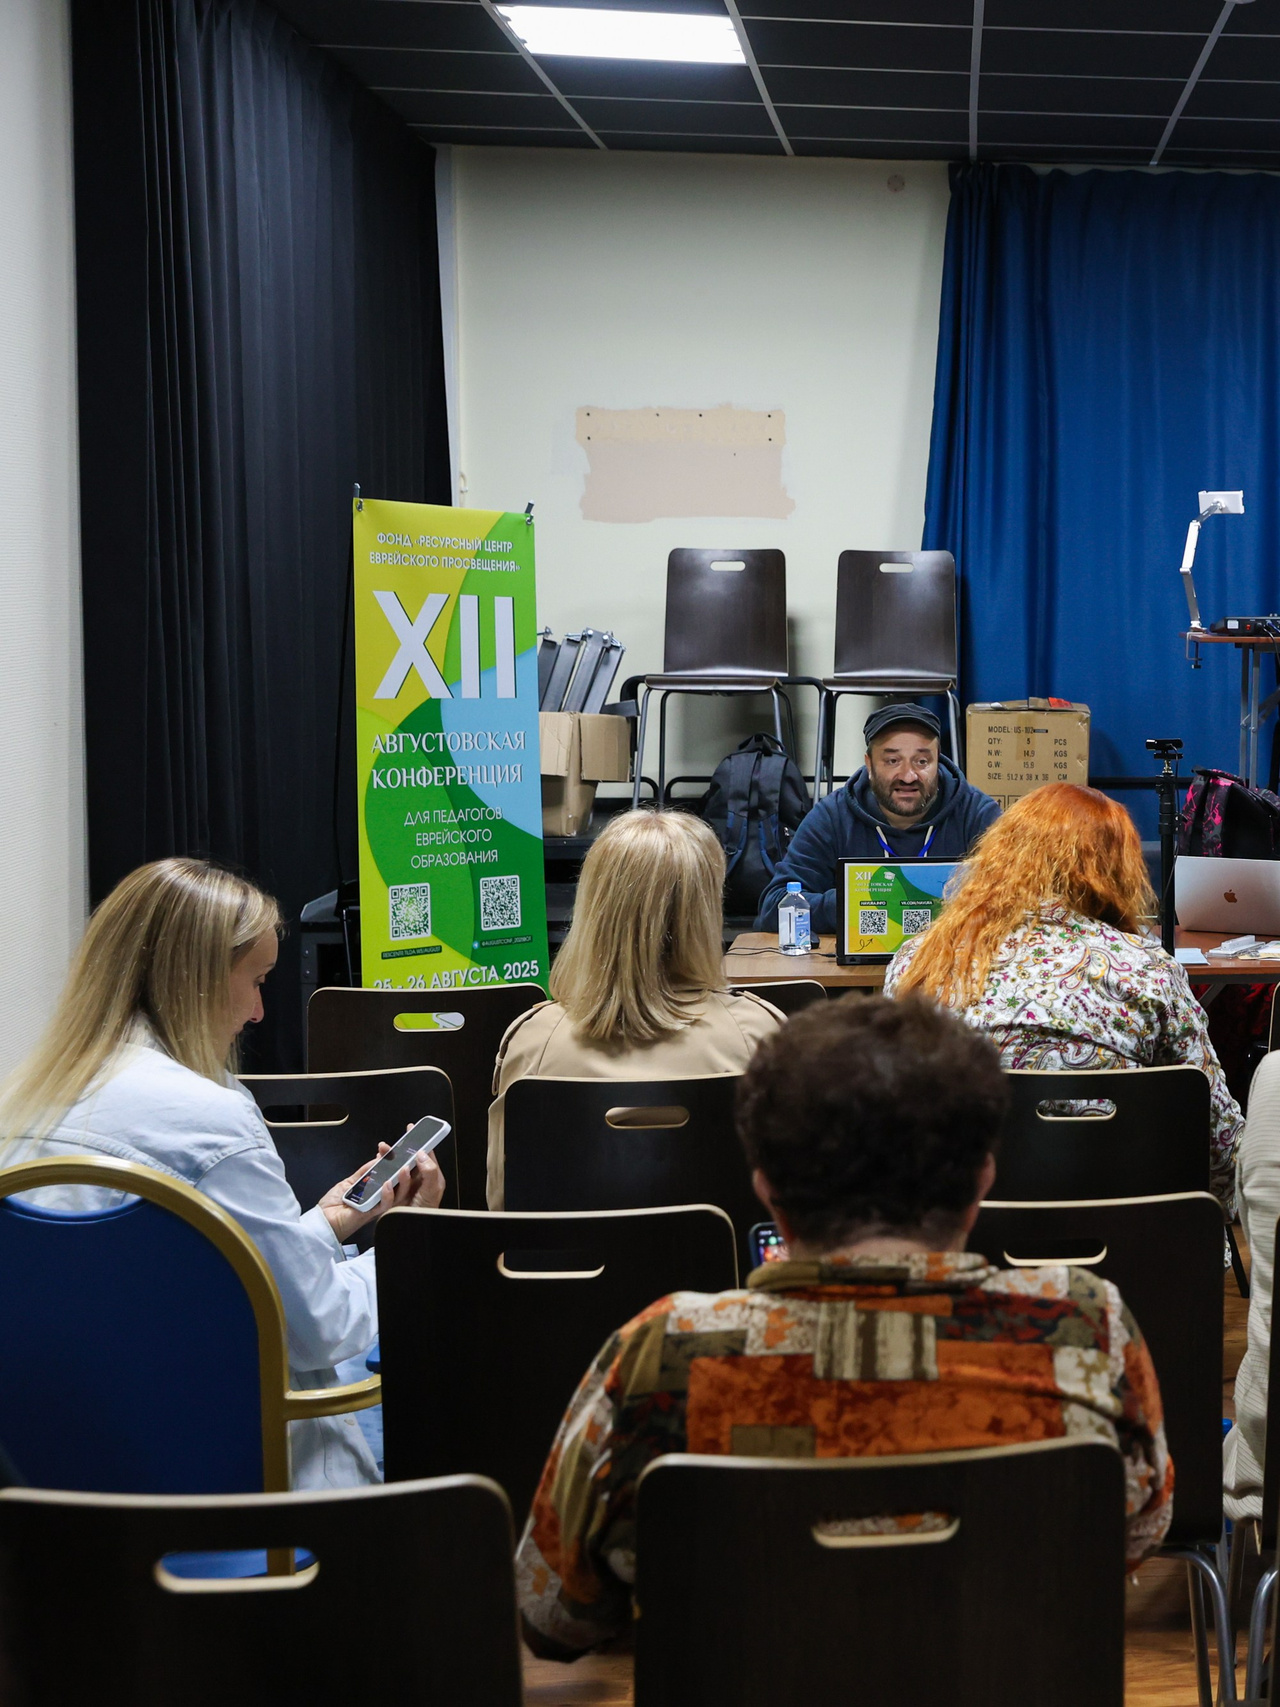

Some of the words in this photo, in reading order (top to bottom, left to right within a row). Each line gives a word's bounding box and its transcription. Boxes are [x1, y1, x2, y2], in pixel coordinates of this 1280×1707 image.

[377, 532, 412, 547] ФОНД
[415, 534, 482, 551] «РЕСУРСНЫЙ
[484, 540, 513, 553] ЦЕНТР
[369, 551, 439, 567] ЕВРЕЙСКОГО
[442, 556, 521, 572] ПРОСВЕЩЕНИЯ»
[372, 590, 517, 699] XII
[371, 730, 526, 754] АВГУСТОВСКАЯ
[1054, 750, 1068, 758] KGS
[372, 764, 523, 789] КОНФЕРЕНЦИЯ
[404, 811, 430, 827] ДЛЯ
[433, 807, 502, 824] ПЕДАГОГОВ
[416, 829, 492, 847] ЕВРЕЙСКОГО
[411, 850, 498, 869] ОБРАЗОВАНИЯ
[855, 872, 872, 880] XII
[407, 974, 426, 989] 26
[430, 964, 500, 989] АВГУСТА
[503, 960, 540, 980] 2025
